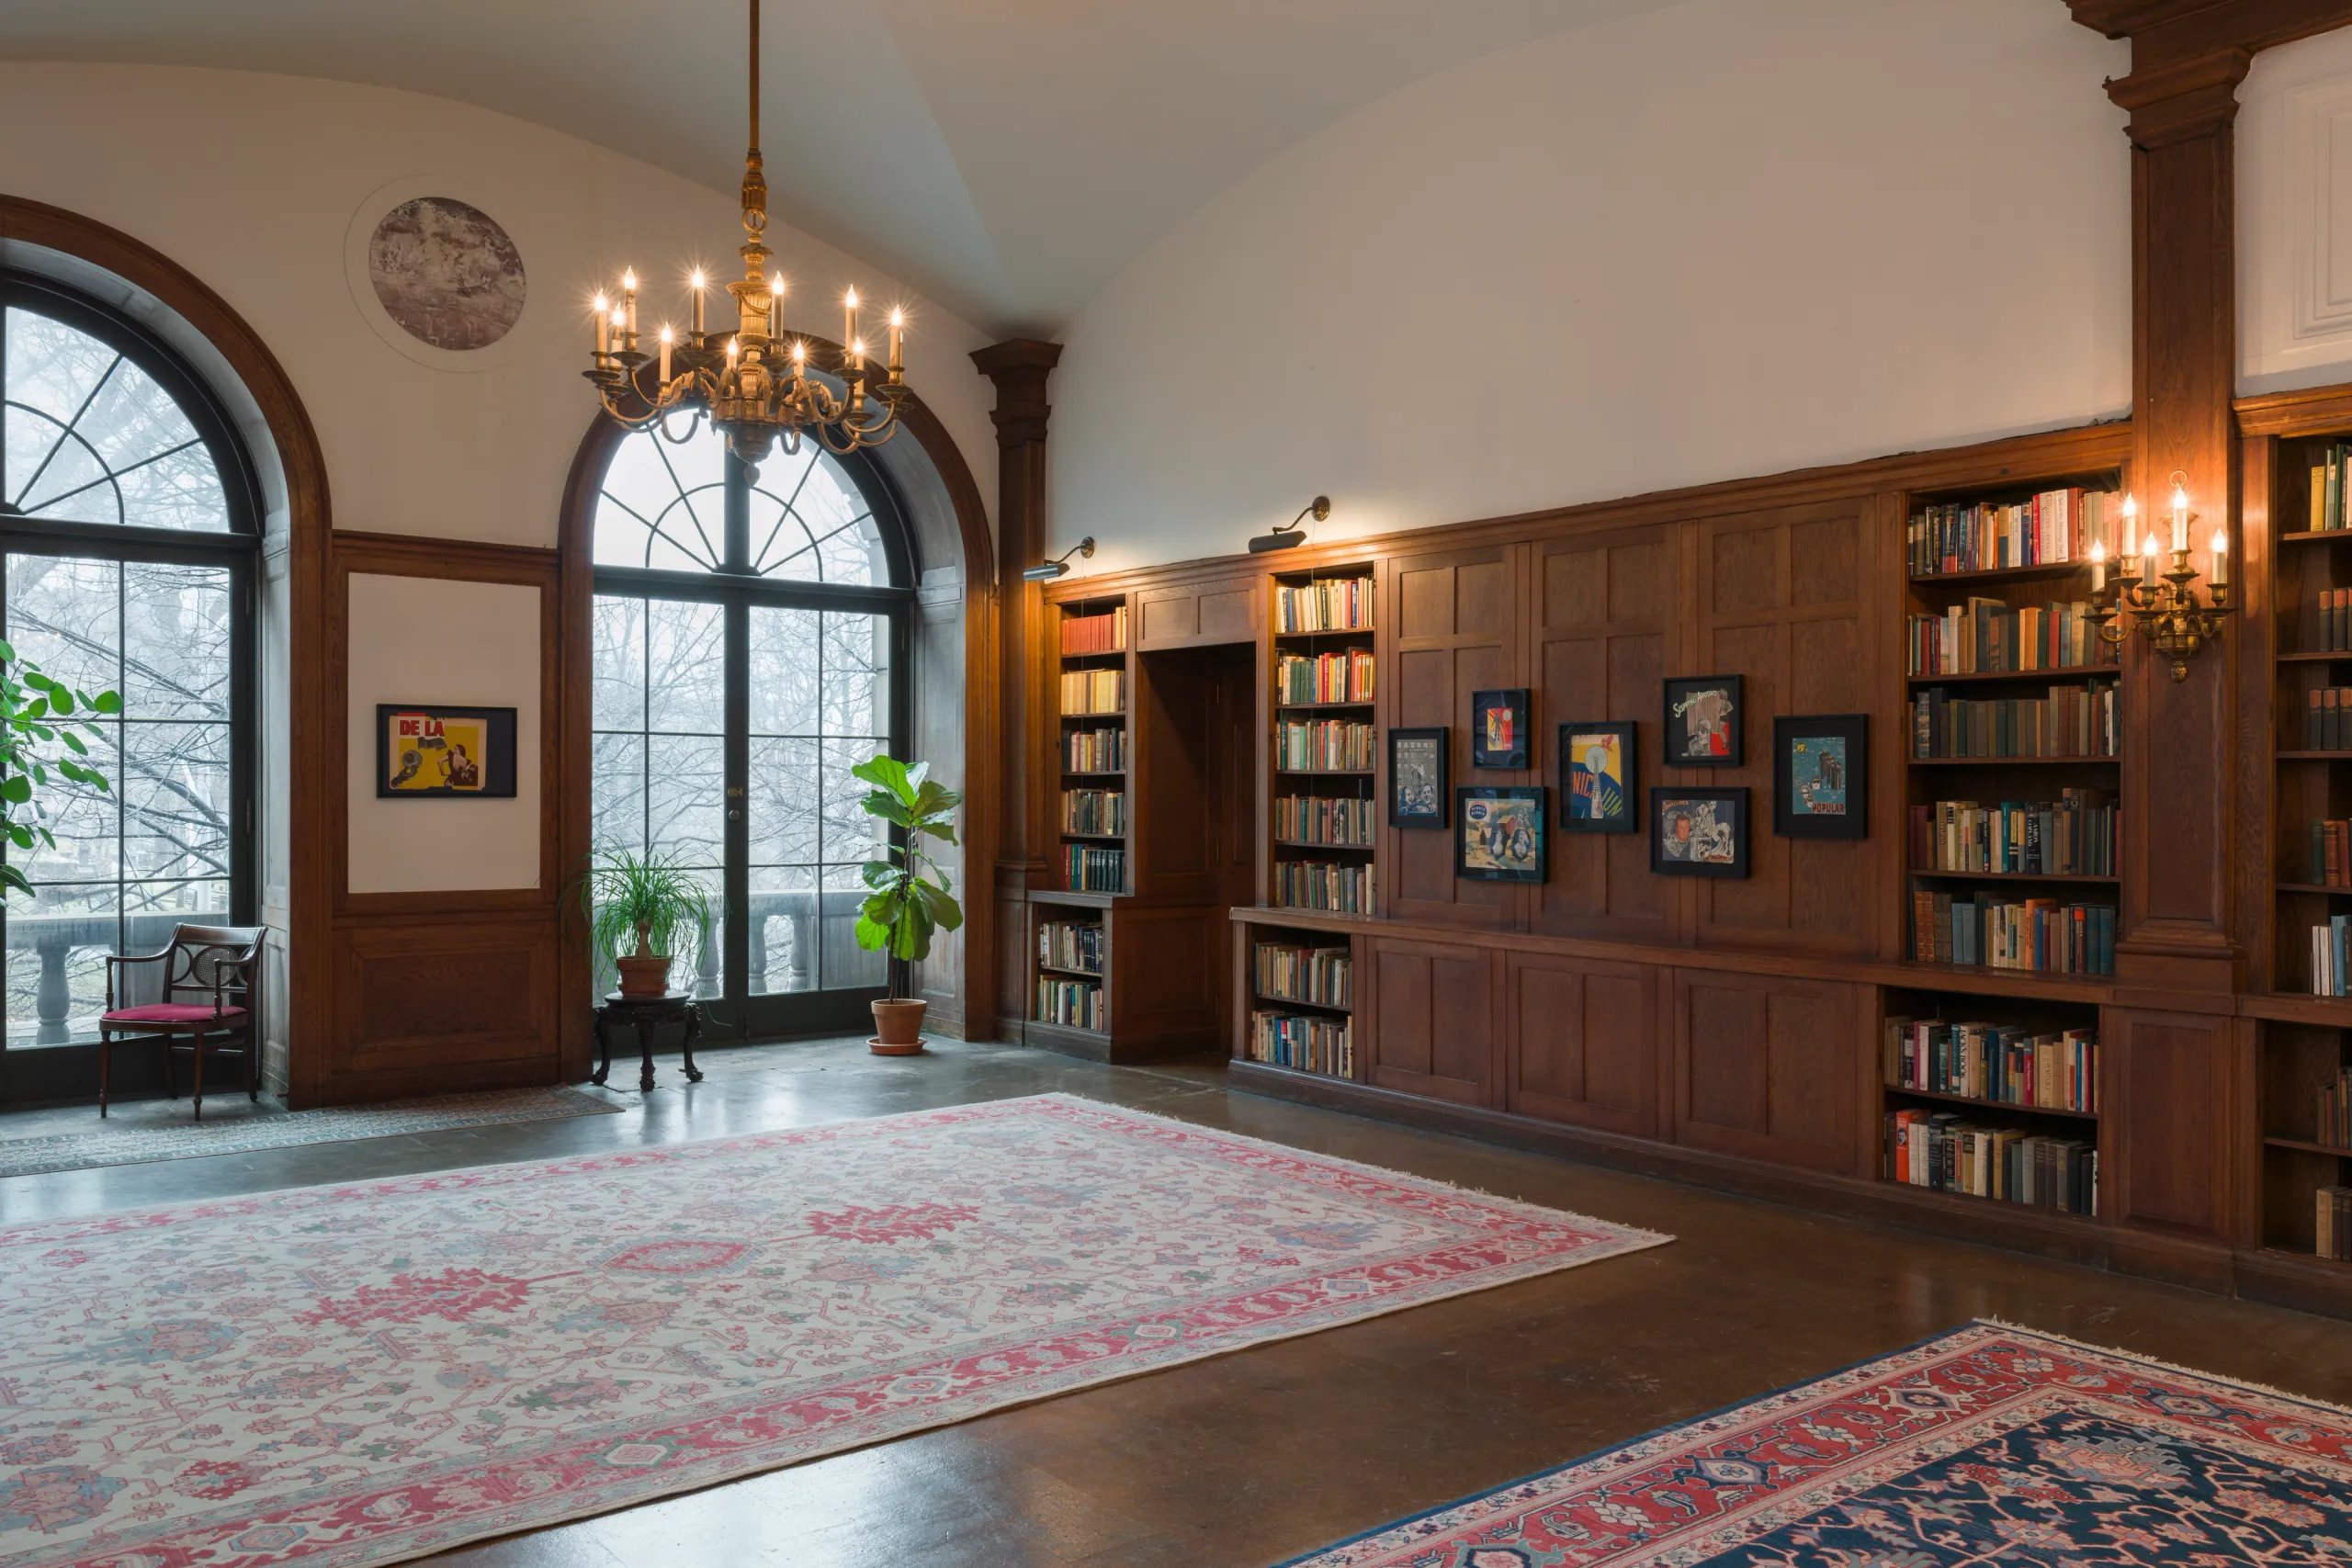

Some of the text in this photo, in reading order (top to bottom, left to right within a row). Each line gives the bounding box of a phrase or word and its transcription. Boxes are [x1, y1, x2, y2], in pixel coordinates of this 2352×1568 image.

[1697, 690, 1717, 702] AROUND
[400, 719, 445, 737] DE LA
[1812, 803, 1845, 813] POPULAR
[1959, 1029, 1968, 1079] JACK'S BOOK
